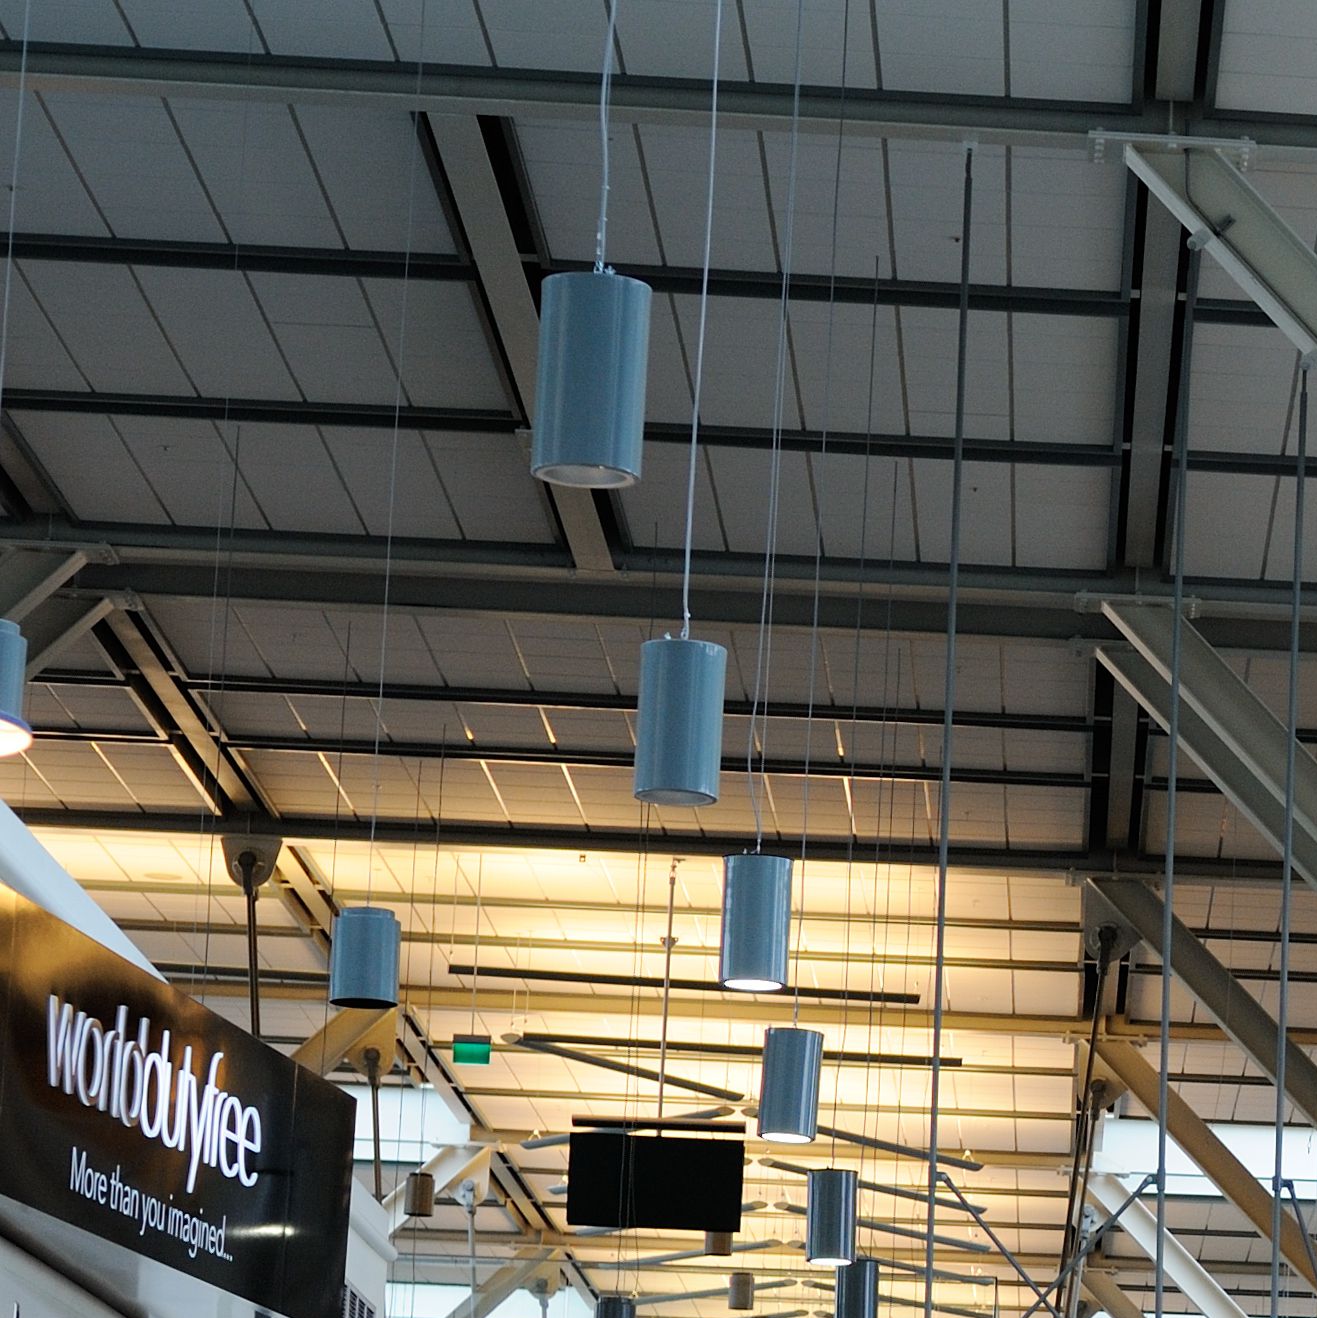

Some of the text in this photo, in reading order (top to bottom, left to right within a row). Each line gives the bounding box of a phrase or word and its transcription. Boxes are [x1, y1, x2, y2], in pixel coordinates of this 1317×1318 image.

[69, 1146, 234, 1262] More than you imagined...
